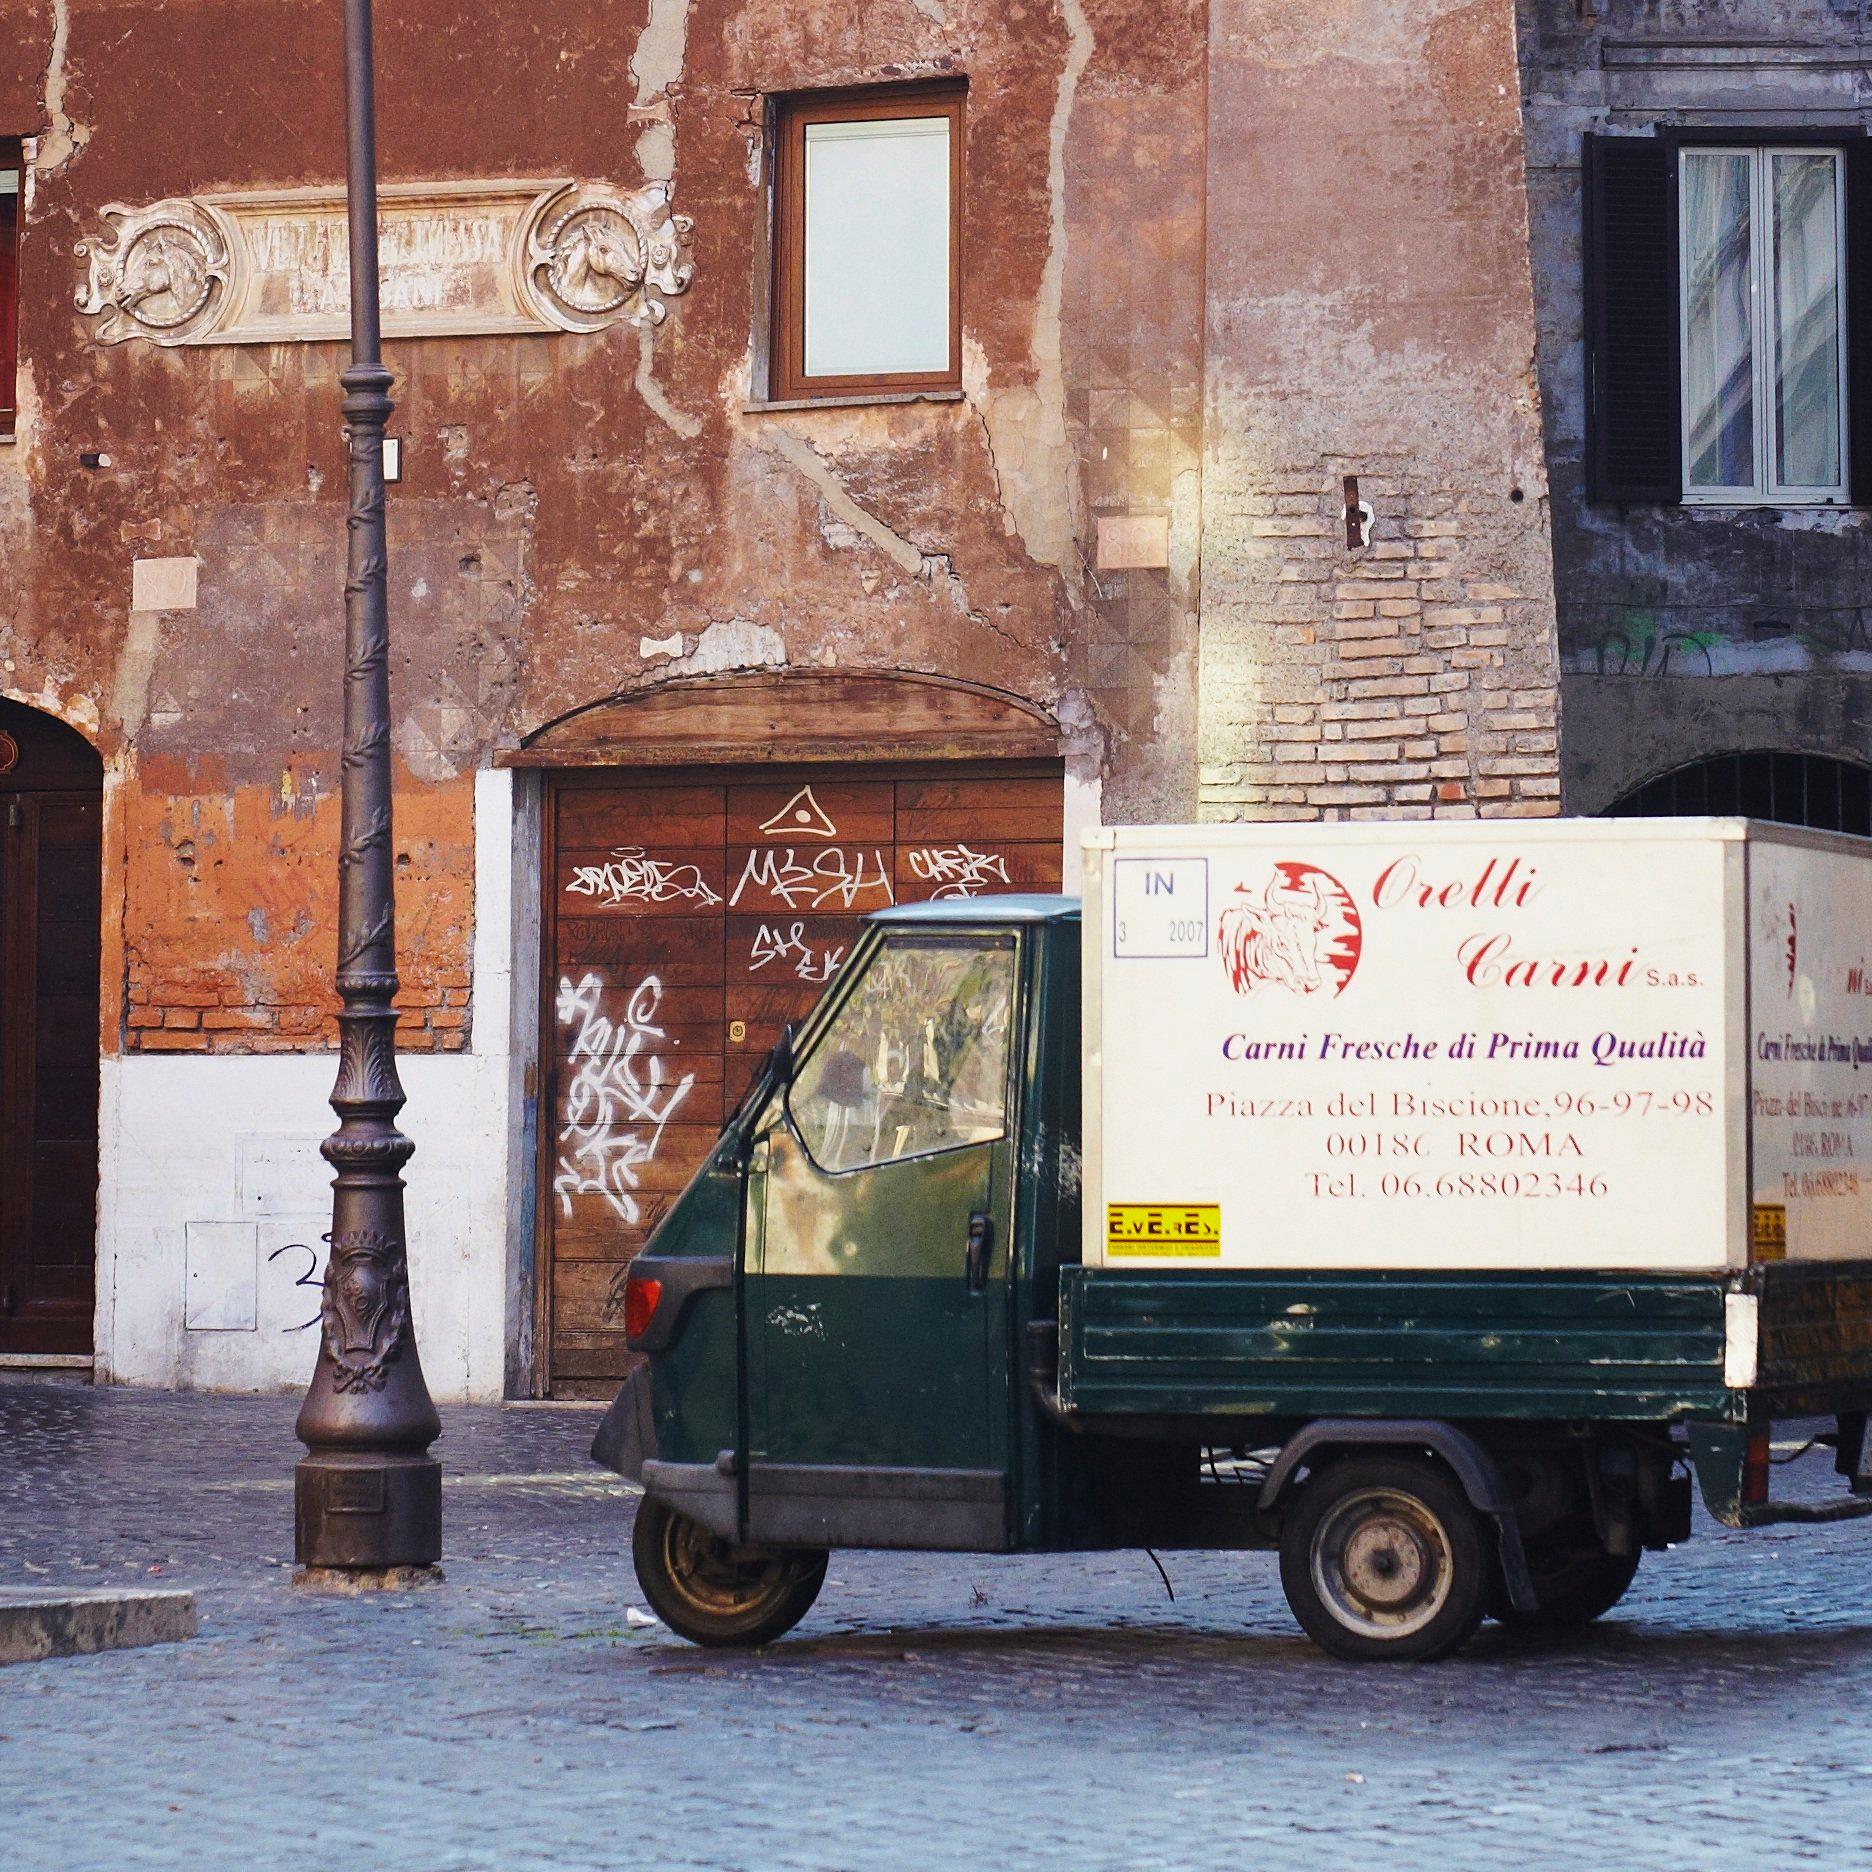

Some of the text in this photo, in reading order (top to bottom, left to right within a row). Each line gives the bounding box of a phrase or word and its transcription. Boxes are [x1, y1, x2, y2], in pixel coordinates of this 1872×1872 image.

[1145, 872, 1174, 896] IN
[1373, 853, 1545, 909] Orelli
[1169, 920, 1204, 943] 2007
[1457, 932, 1705, 989] Carni S.a.s.
[1223, 1030, 1707, 1066] Carni Fresche di Prima Qualità
[1206, 1091, 1313, 1118] Piazza
[1327, 1091, 1376, 1118] del
[1458, 1132, 1585, 1158] ROMA
[1305, 1171, 1608, 1199] Tel. 06.68802346
